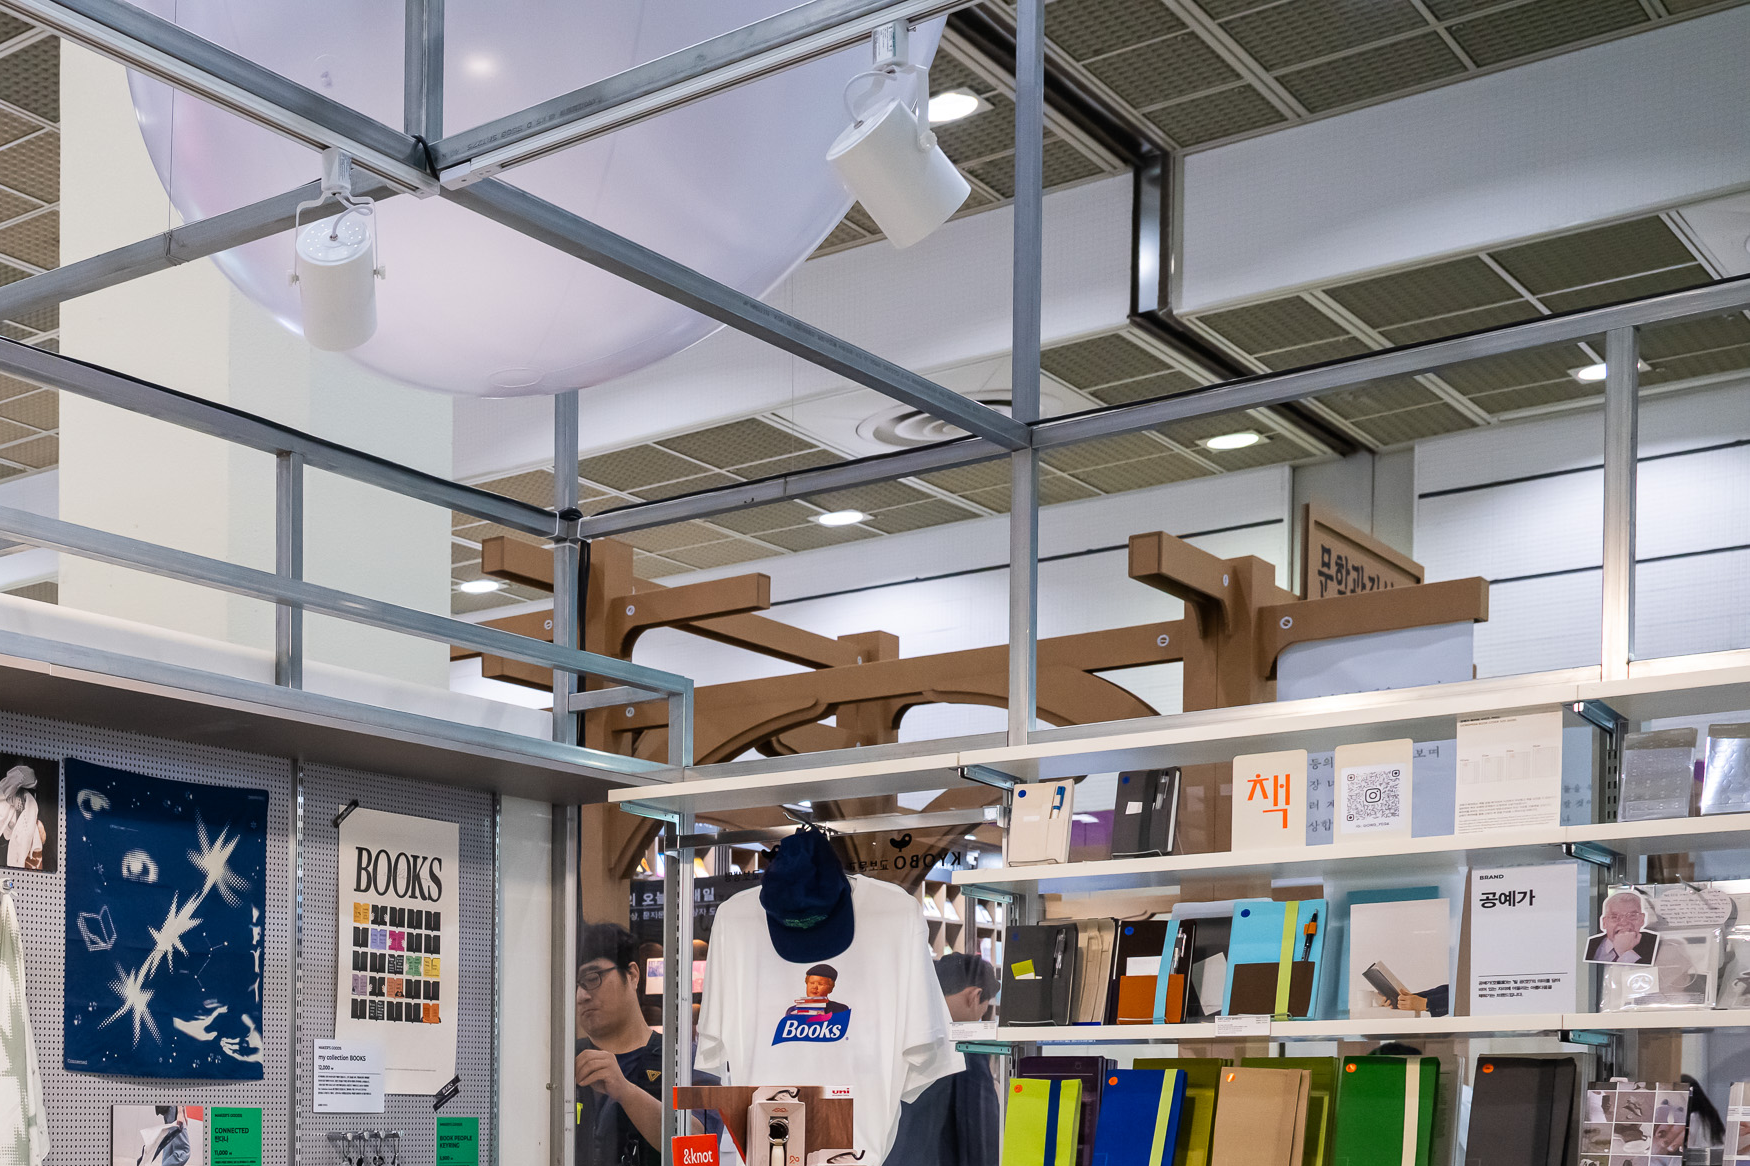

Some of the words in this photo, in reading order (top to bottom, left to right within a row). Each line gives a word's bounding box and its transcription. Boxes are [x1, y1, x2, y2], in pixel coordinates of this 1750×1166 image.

[1247, 773, 1290, 828] 책
[354, 846, 442, 902] BOOKS
[1479, 889, 1535, 908] 공예가
[782, 1021, 842, 1039] Books
[684, 1148, 713, 1164] &knot
